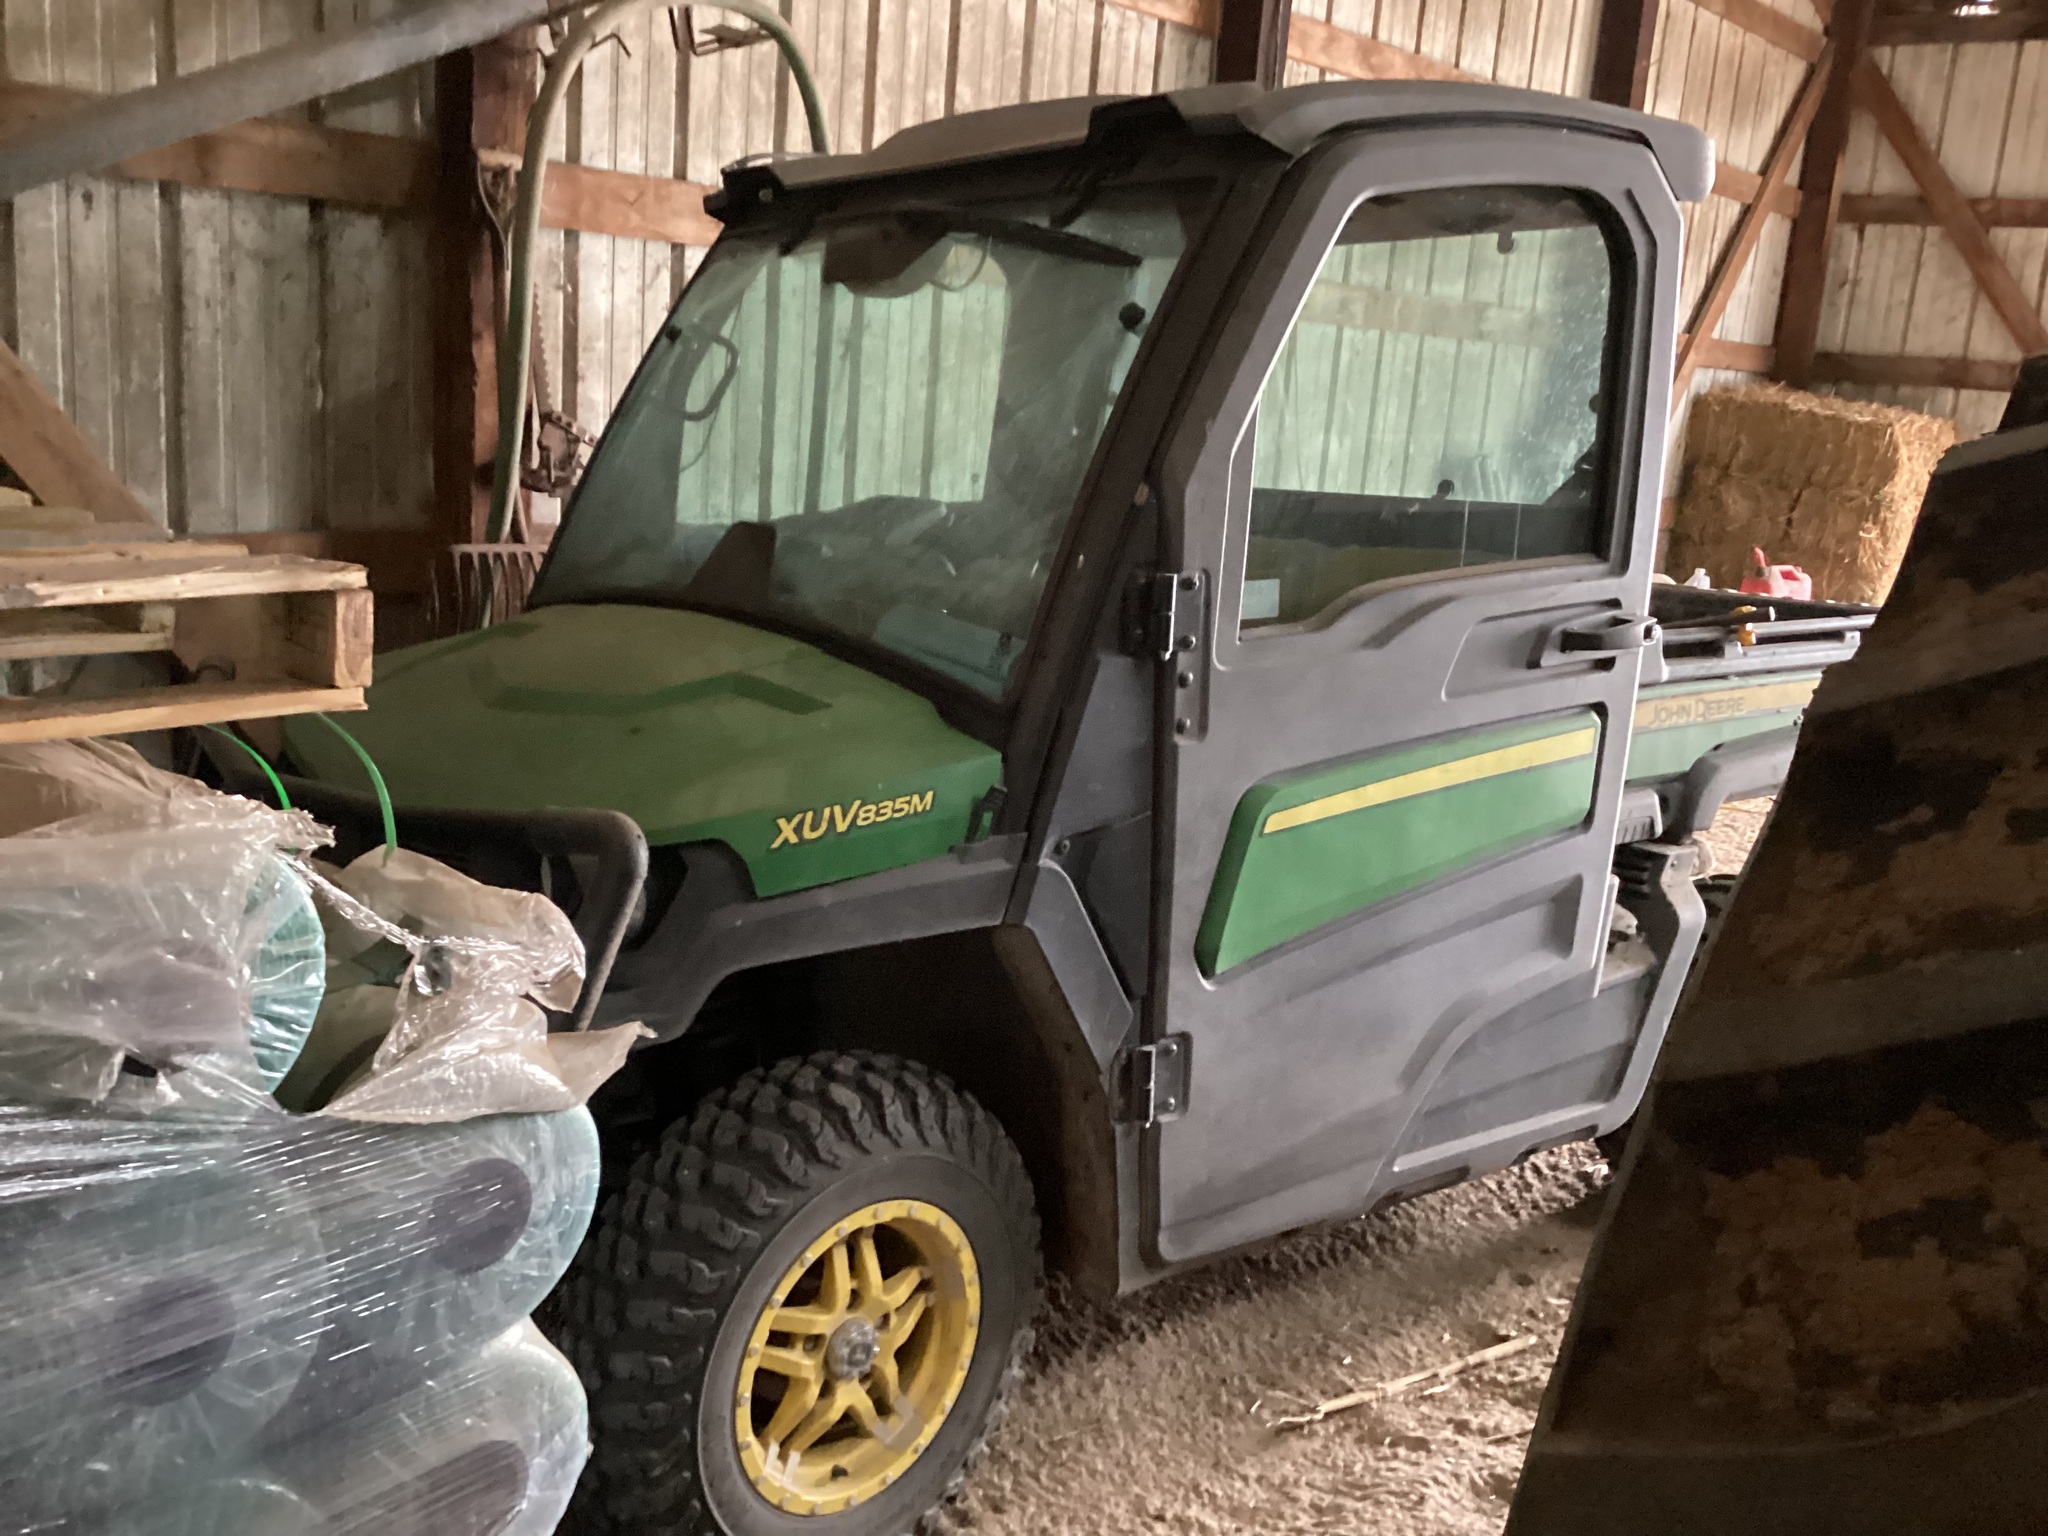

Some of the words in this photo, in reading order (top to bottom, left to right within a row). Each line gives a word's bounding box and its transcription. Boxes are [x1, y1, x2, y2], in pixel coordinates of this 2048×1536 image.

[1650, 702, 1692, 724] JOHN
[1694, 697, 1745, 720] DEERE
[769, 790, 934, 849] XUV835M
